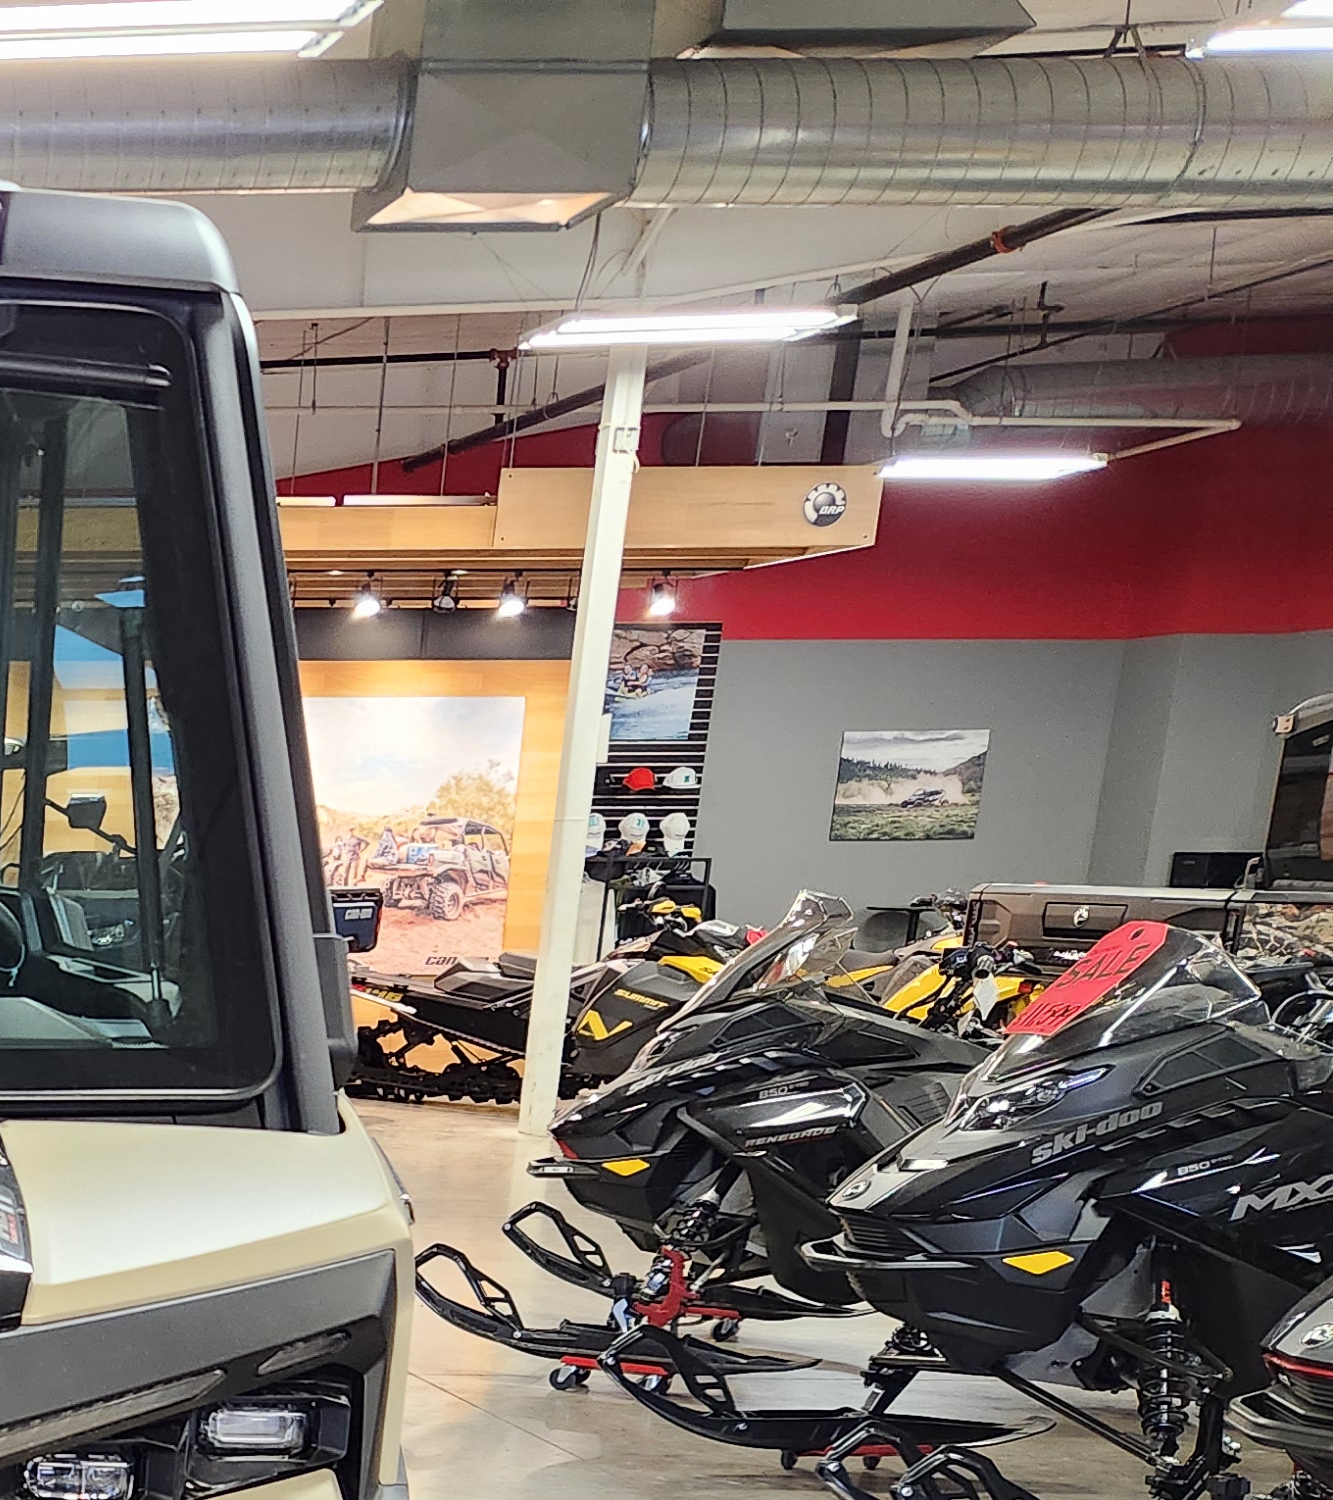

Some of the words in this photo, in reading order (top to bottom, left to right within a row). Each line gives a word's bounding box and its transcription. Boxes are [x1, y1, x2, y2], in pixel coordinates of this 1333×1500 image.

[818, 505, 845, 515] BRP
[1055, 943, 1151, 988] SALE
[759, 1086, 789, 1099] 850
[744, 1125, 840, 1148] RENEGADE
[1177, 1160, 1211, 1176] 850
